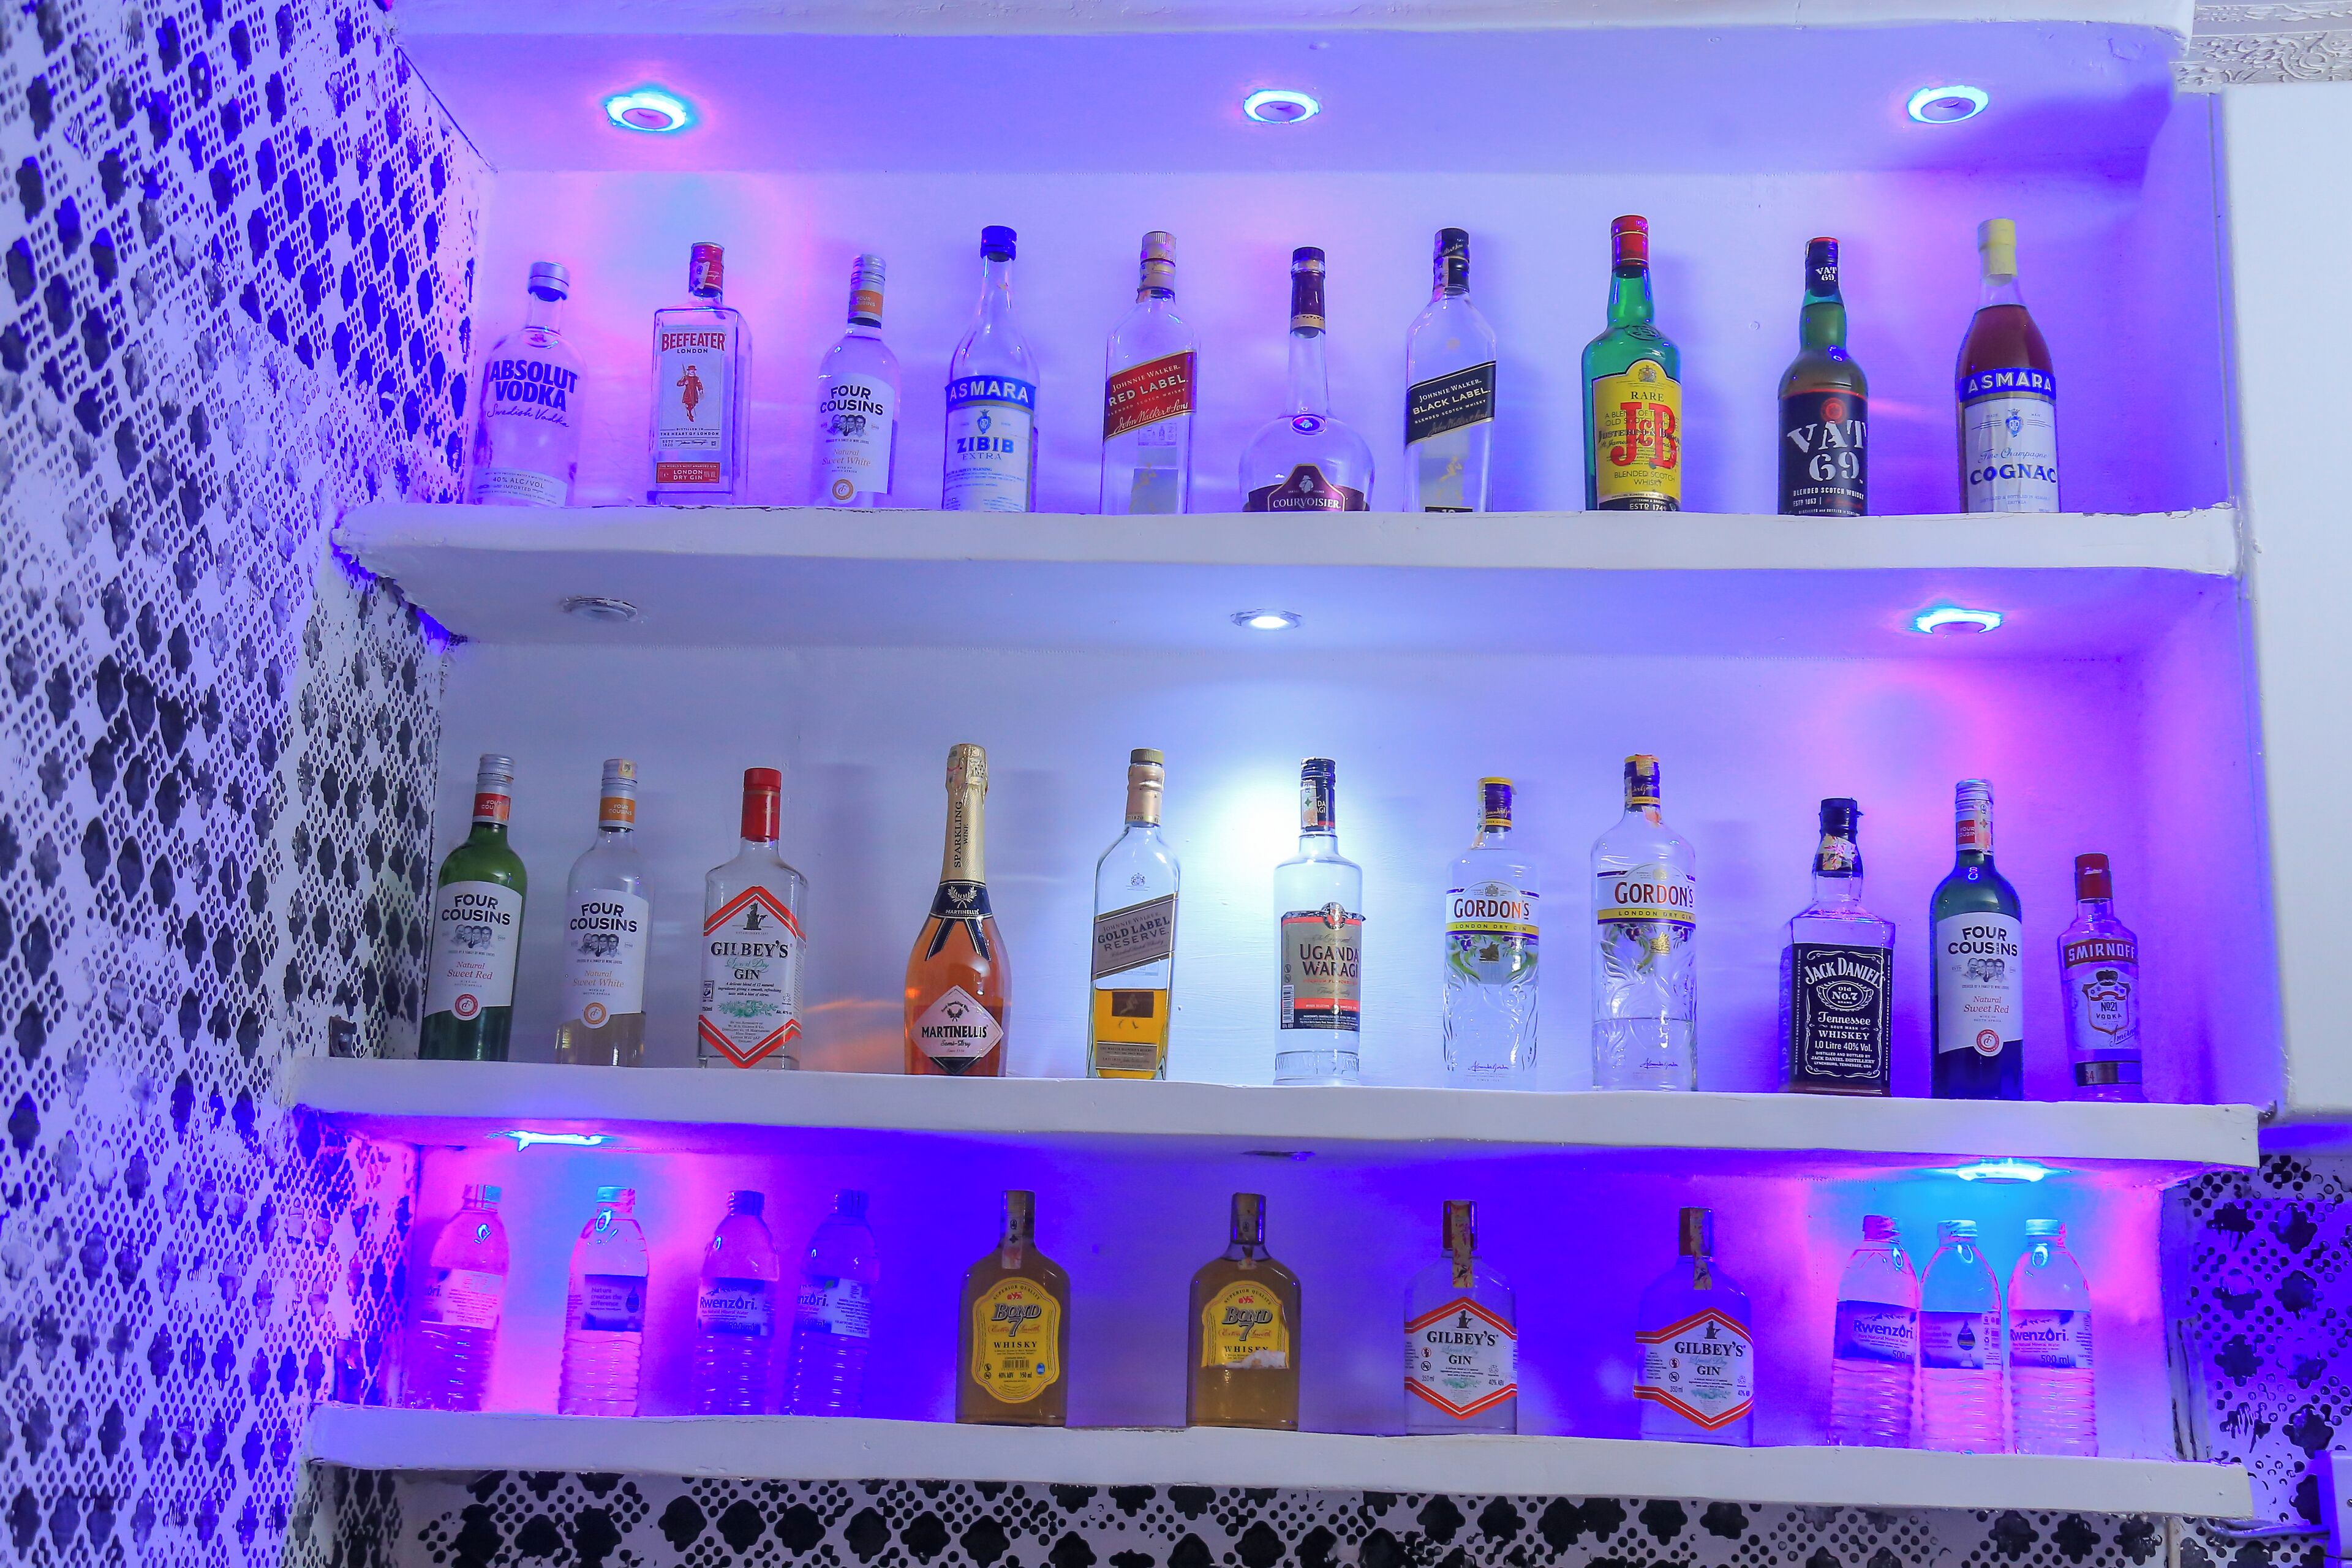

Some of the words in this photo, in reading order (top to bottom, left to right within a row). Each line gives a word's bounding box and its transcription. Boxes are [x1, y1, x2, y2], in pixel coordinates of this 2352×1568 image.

[662, 333, 725, 353] BEEFEATER
[489, 360, 578, 394] ABSOLUT
[1113, 376, 1145, 393] JOHNNIE
[1969, 371, 2052, 393] ASMARA
[496, 380, 567, 412] VODKA
[830, 385, 872, 401] FOUR
[949, 380, 1028, 403] ASMARA
[1109, 389, 1136, 406] RED
[1137, 396, 1159, 405] SCOTCH
[1163, 388, 1185, 397] WHISKY
[1419, 388, 1450, 402] JOHNNIE
[1631, 391, 1664, 402] RARE
[487, 404, 533, 418] Swedish
[820, 399, 884, 416] COUSINS
[1412, 398, 1449, 415] BLACK
[1415, 413, 1439, 424] BLENDED
[1442, 407, 1463, 416] SCOTCH
[1466, 399, 1486, 409] WHISKY
[535, 409, 569, 428] Vodka
[1114, 416, 1137, 434] John
[1605, 418, 1621, 427] OLD
[1787, 420, 1866, 453] VAT
[833, 447, 860, 456] Natural
[957, 436, 1014, 454] ZIBIB
[822, 456, 844, 466] Sweet
[846, 456, 870, 467] White
[1978, 448, 1999, 464] Fine
[2000, 447, 2048, 463] Champagne
[1809, 452, 1860, 481] 69
[1970, 463, 2057, 486] COGNAC
[1614, 470, 1648, 479] BLENDED
[1651, 471, 1675, 481] SCOTCH
[1634, 478, 1662, 487] WHISKY
[503, 484, 532, 492] IMPORTED
[1793, 487, 1819, 496] BLENDED
[1846, 488, 1864, 500] WHISKY
[954, 801, 963, 867] SPARKLING
[454, 894, 499, 910] FOUR
[1615, 881, 1693, 908] GORDON'S
[581, 902, 625, 918] FOUR
[1453, 899, 1529, 919] GORDON'S
[441, 909, 511, 926] COUSINS
[570, 917, 638, 933] COUSINS
[1098, 927, 1128, 944] GOLD
[1131, 916, 1170, 934] LABEL
[1103, 920, 1130, 932] JOHNNIE
[1962, 925, 2007, 941] FOUR
[710, 940, 788, 958] GILBEY'S
[1300, 944, 1359, 963] UGANDA
[1948, 941, 2018, 957] COUSINS
[2068, 943, 2135, 962] SMIRNOFF
[456, 961, 485, 970] Natural
[1804, 961, 1836, 985] JACK
[447, 969, 472, 978] Sweet
[476, 970, 494, 980] Red
[734, 969, 760, 980] GIN
[573, 978, 597, 987] Sweet
[599, 978, 625, 988] White
[1831, 991, 1858, 1001] No.7
[1964, 1004, 1991, 1012] Sweet
[1994, 1005, 2010, 1014] Red
[1818, 1011, 1871, 1025] Tennessee
[921, 1025, 987, 1039] MARTINELLIS
[1818, 1030, 1870, 1041] WHISKEY
[1825, 1041, 1842, 1050] Litre
[1844, 1042, 1859, 1052] 40%
[1860, 1042, 1872, 1052] Vol.
[993, 1285, 1017, 1300] SUPERIOR
[1020, 1285, 1040, 1300] QUALITY
[1224, 1289, 1250, 1303] SUPERIOR
[1252, 1289, 1272, 1305] QUALITY
[991, 1303, 1042, 1321] BOND
[1222, 1306, 1273, 1325] BOND
[1008, 1318, 1023, 1337] 7
[1239, 1322, 1254, 1341] 7
[1427, 1330, 1496, 1346] GILBEY'S
[1674, 1341, 1743, 1357] GILBEY'S
[1893, 1349, 1905, 1360] 500
[1449, 1355, 1472, 1365] GIN
[2041, 1354, 2057, 1363] 500
[2059, 1354, 2070, 1365] ml
[1697, 1365, 1721, 1376] GIN
